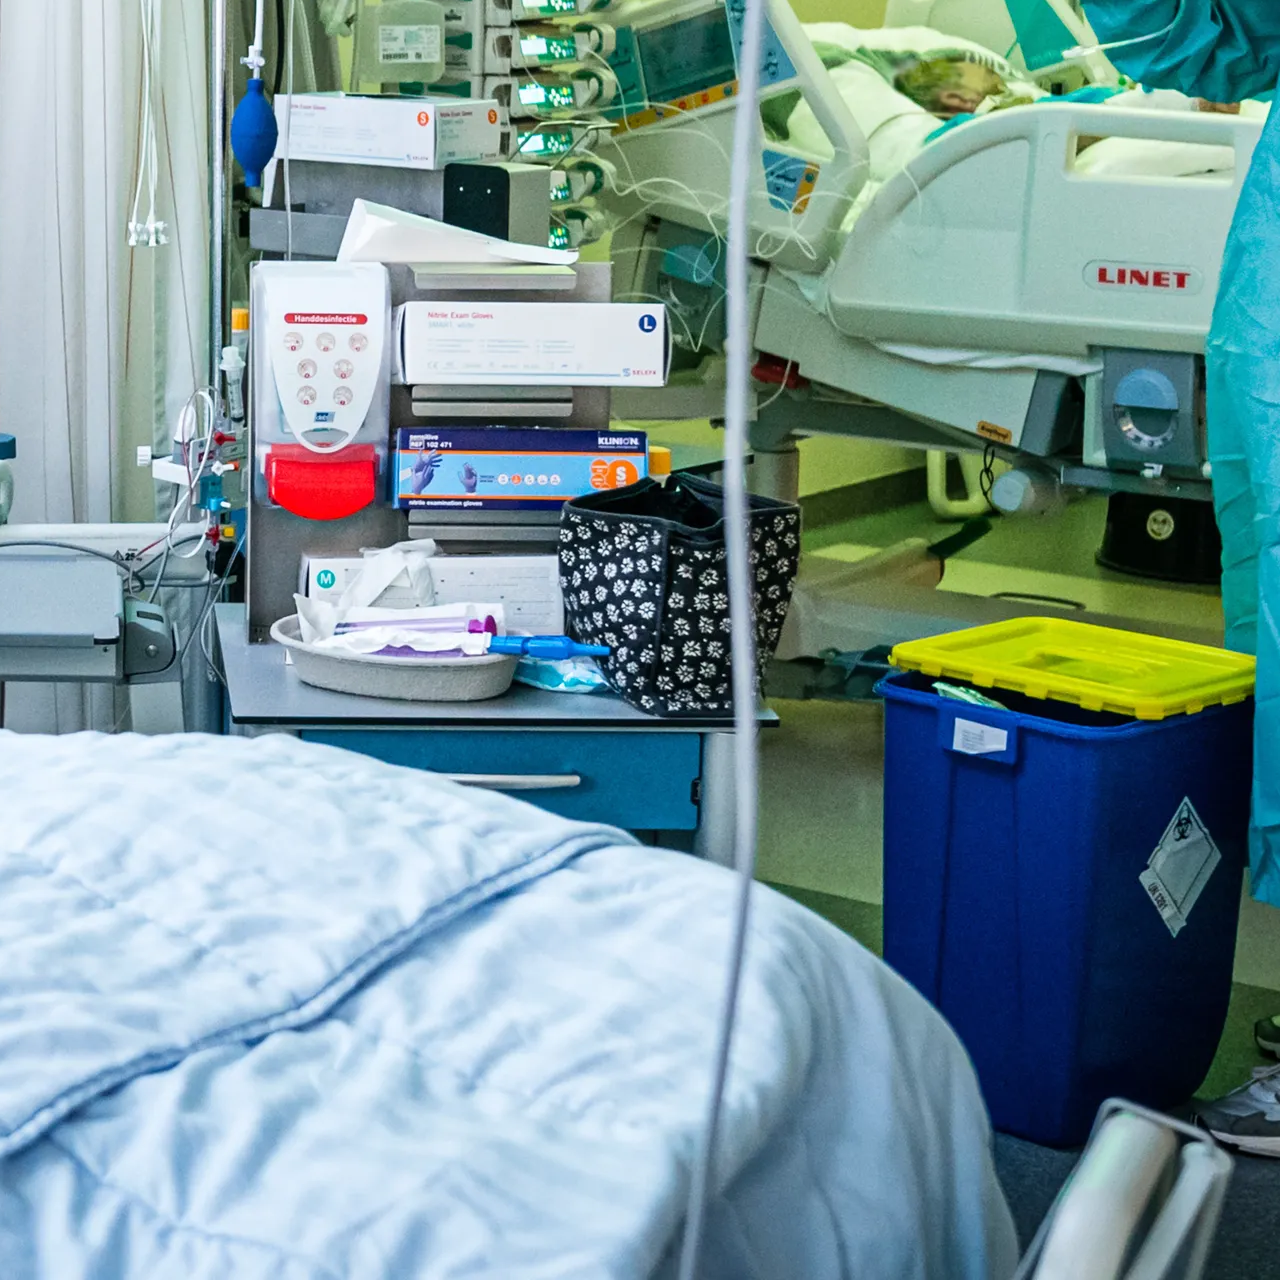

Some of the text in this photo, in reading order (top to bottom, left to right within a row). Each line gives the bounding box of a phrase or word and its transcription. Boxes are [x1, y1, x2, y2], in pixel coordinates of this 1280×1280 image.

[1098, 267, 1191, 289] LINET
[294, 314, 357, 323] Handdesinfectie
[427, 311, 494, 319] Nitrile Exam Gloves
[643, 316, 653, 330] L
[616, 466, 626, 480] S
[319, 573, 333, 585] M
